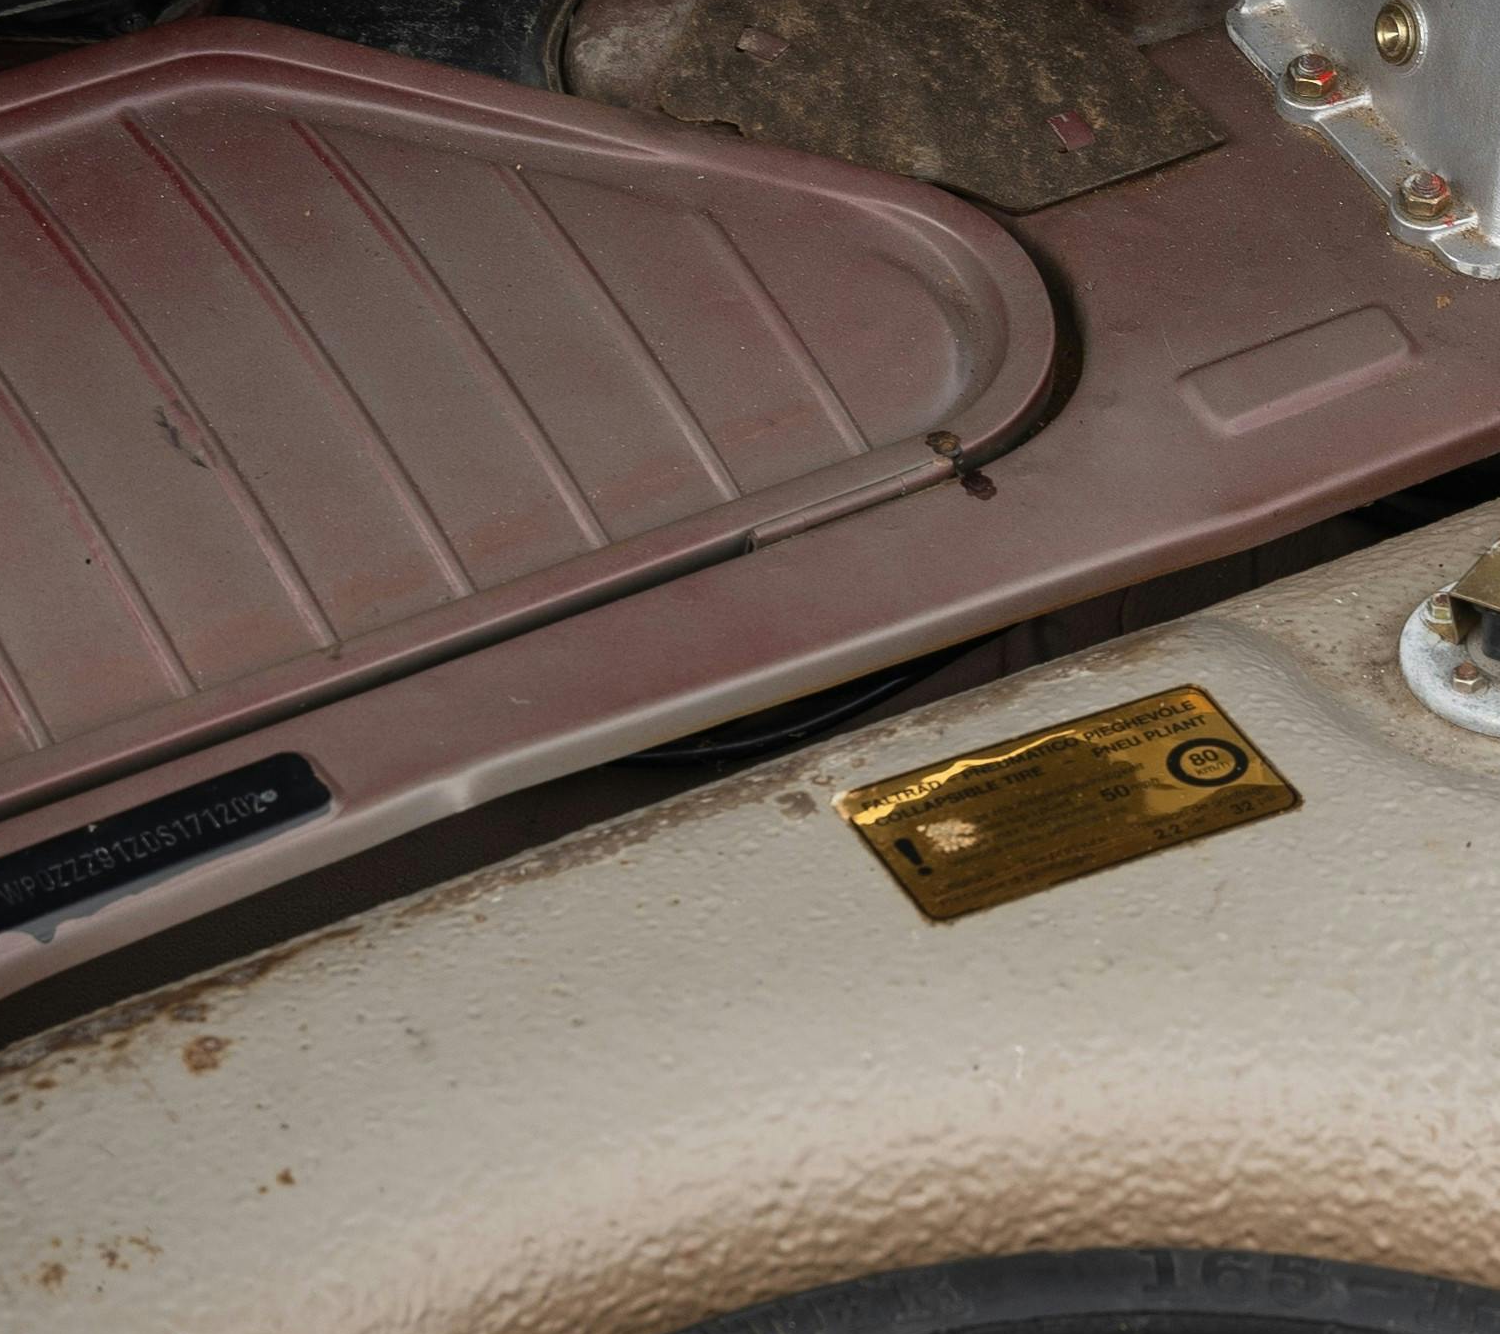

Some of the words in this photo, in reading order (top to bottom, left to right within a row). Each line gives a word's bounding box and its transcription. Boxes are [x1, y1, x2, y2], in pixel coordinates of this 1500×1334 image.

[859, 779, 943, 811] FALTRAD
[959, 736, 1081, 780] PNEUMATICO
[1081, 700, 1196, 741] PIEGHEVOLE
[872, 780, 1000, 826] COLLAPSIBLE
[1002, 765, 1046, 785] TIRE
[1090, 735, 1142, 757] PNEU
[1142, 714, 1209, 741] PLIANT
[1186, 748, 1221, 767] 80
[1097, 783, 1132, 802] 50
